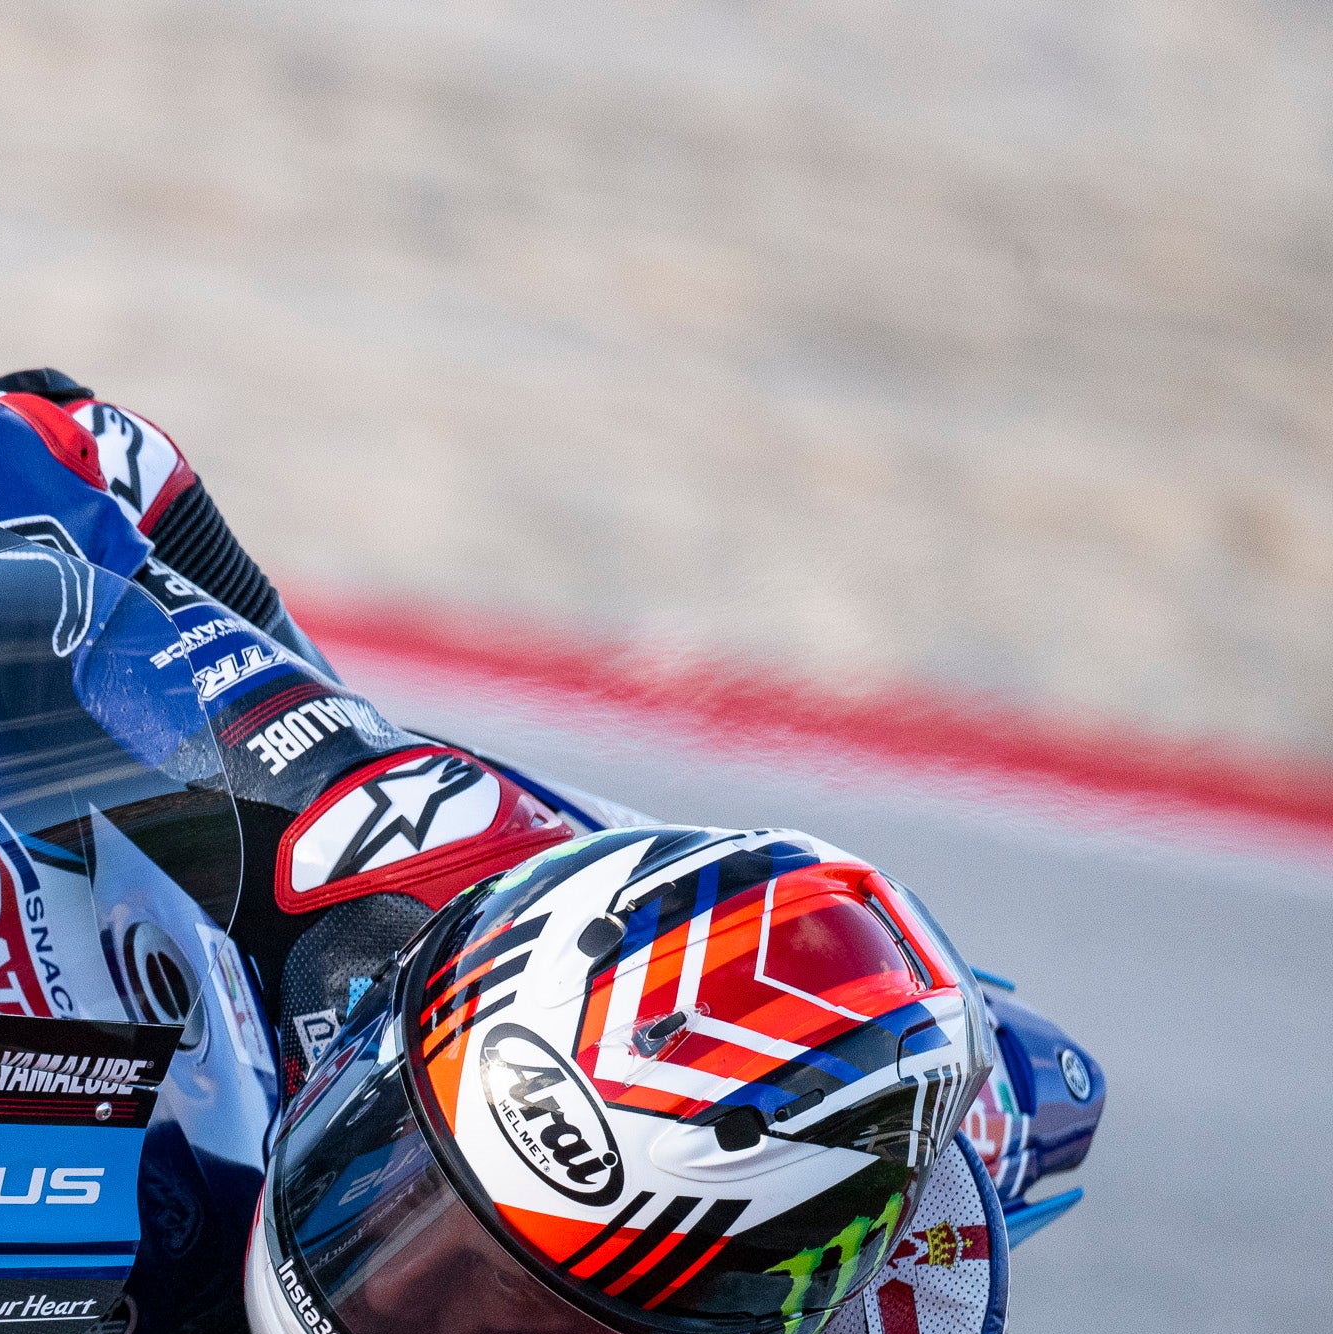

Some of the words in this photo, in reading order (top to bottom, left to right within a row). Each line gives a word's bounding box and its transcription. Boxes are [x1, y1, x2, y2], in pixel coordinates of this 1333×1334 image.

[25, 895, 75, 1020] SNAC
[484, 1047, 618, 1185] Arai
[498, 1099, 551, 1166] HELMET
[20, 1295, 97, 1317] Heart
